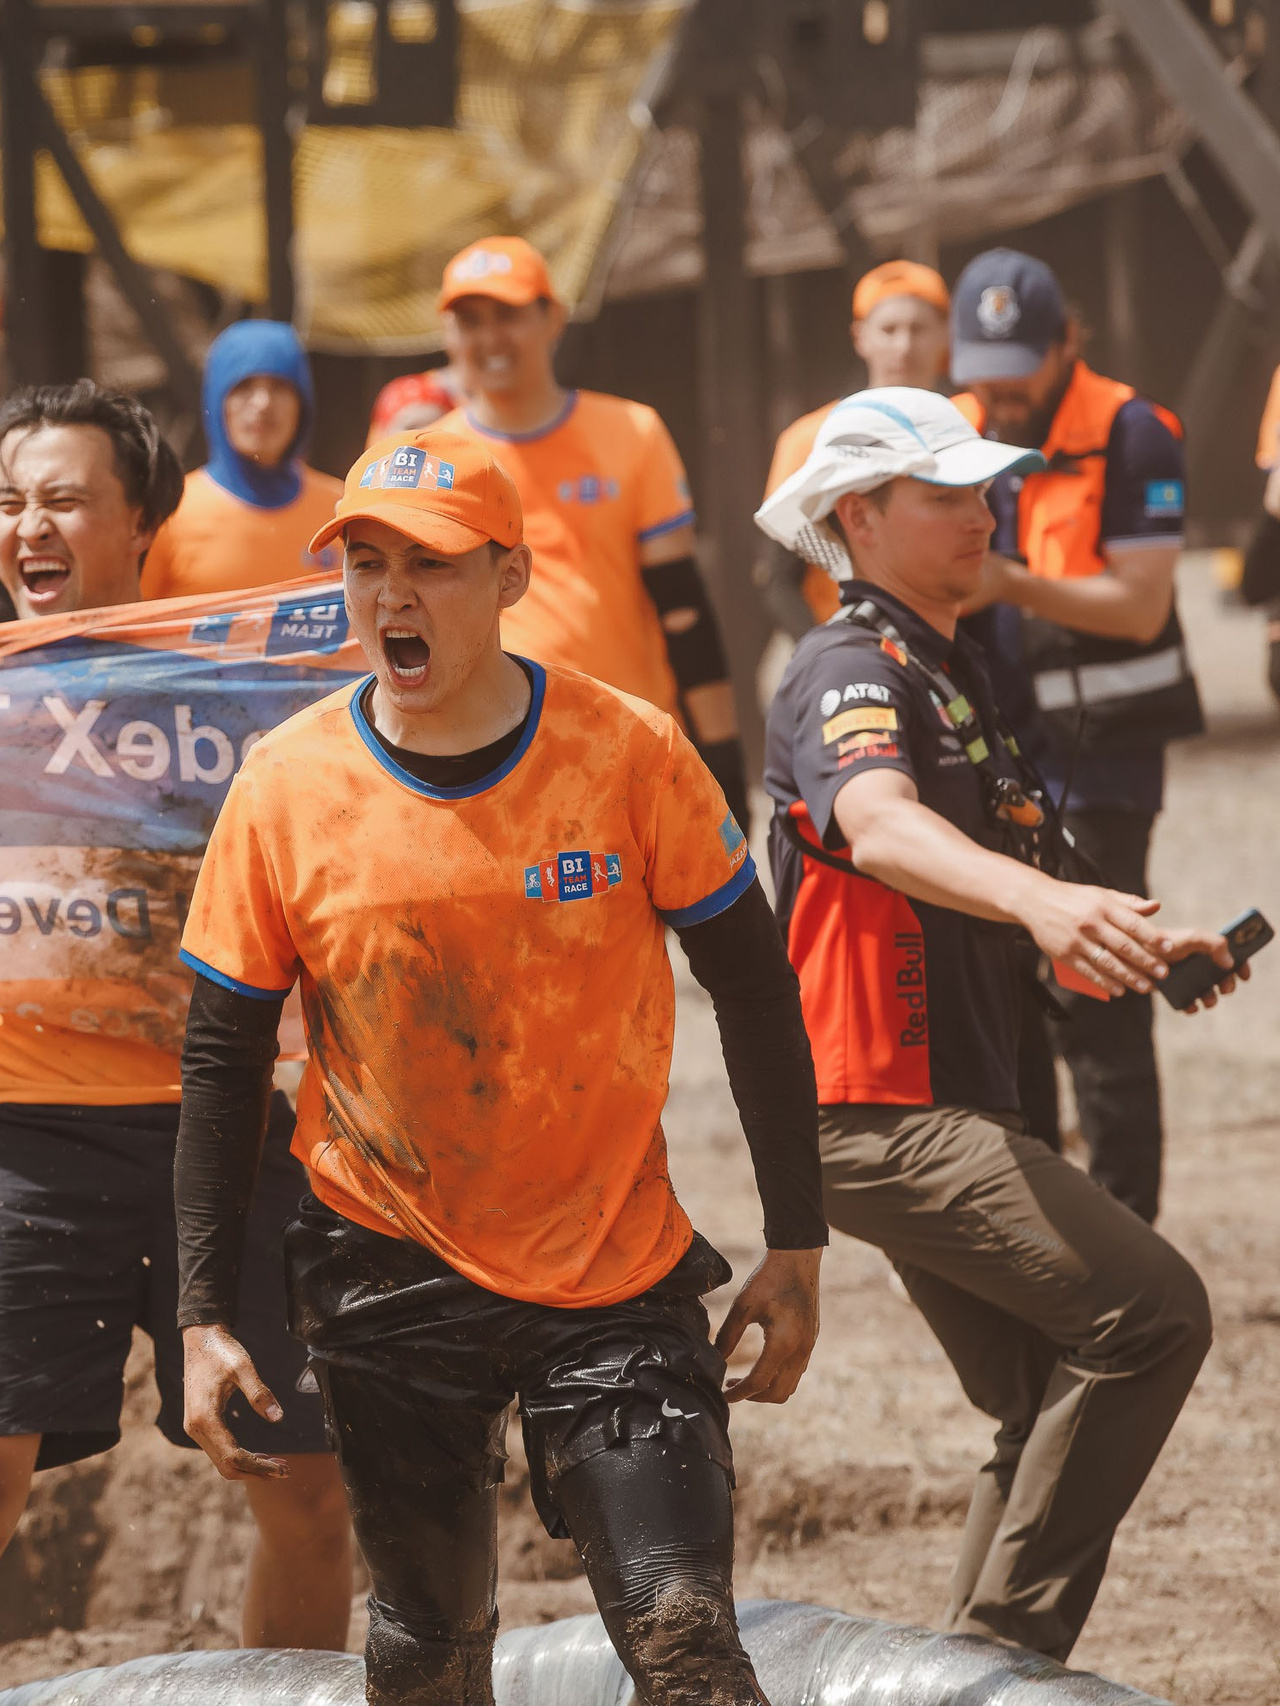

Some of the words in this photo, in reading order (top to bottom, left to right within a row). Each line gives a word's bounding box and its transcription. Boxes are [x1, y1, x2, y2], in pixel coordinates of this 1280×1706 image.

[395, 452, 417, 466] BI
[392, 467, 417, 475] TEAM
[843, 682, 890, 702] AT&T
[562, 857, 584, 874] BI
[563, 874, 588, 884] TEAM
[564, 883, 588, 893] RACE
